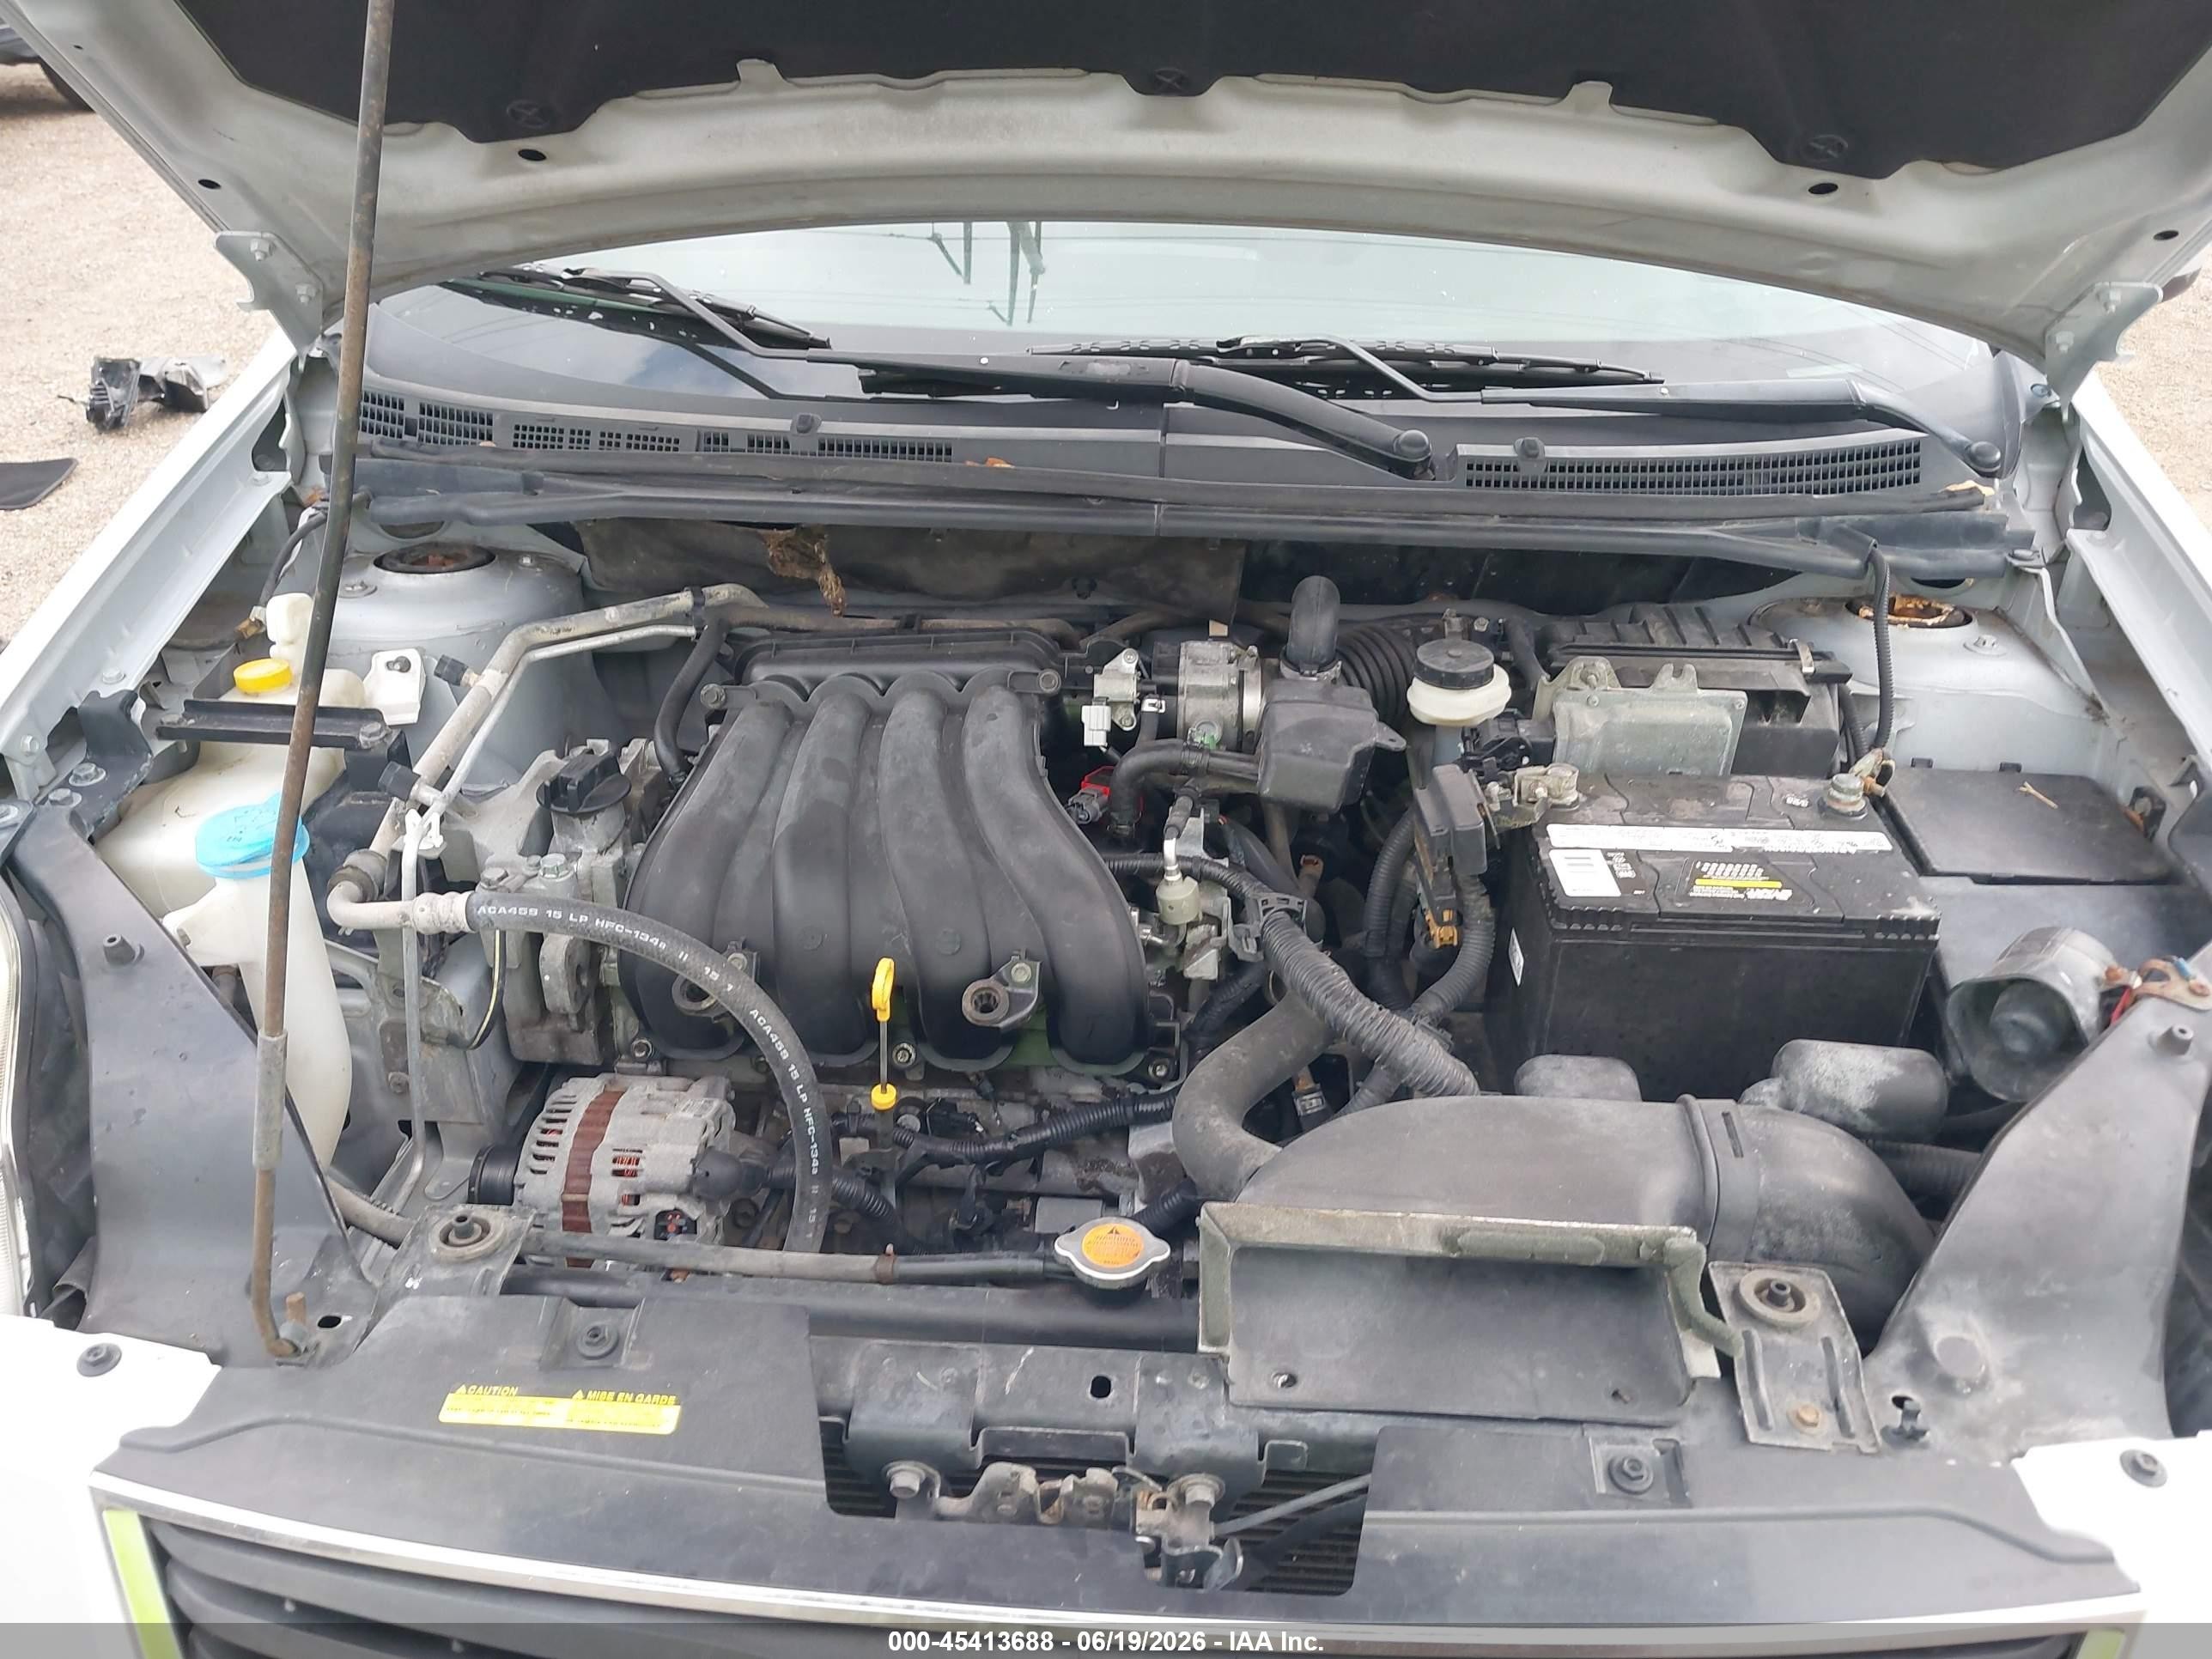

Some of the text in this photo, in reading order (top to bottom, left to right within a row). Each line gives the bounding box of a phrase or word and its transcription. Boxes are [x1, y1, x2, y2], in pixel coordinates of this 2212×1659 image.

[546, 909, 562, 919] 15
[568, 913, 589, 922] LP
[788, 1063, 799, 1080] 15
[796, 1084, 808, 1103] LP
[466, 1384, 519, 1396] CAUTION
[586, 1390, 676, 1406] MISE EN GARDE
